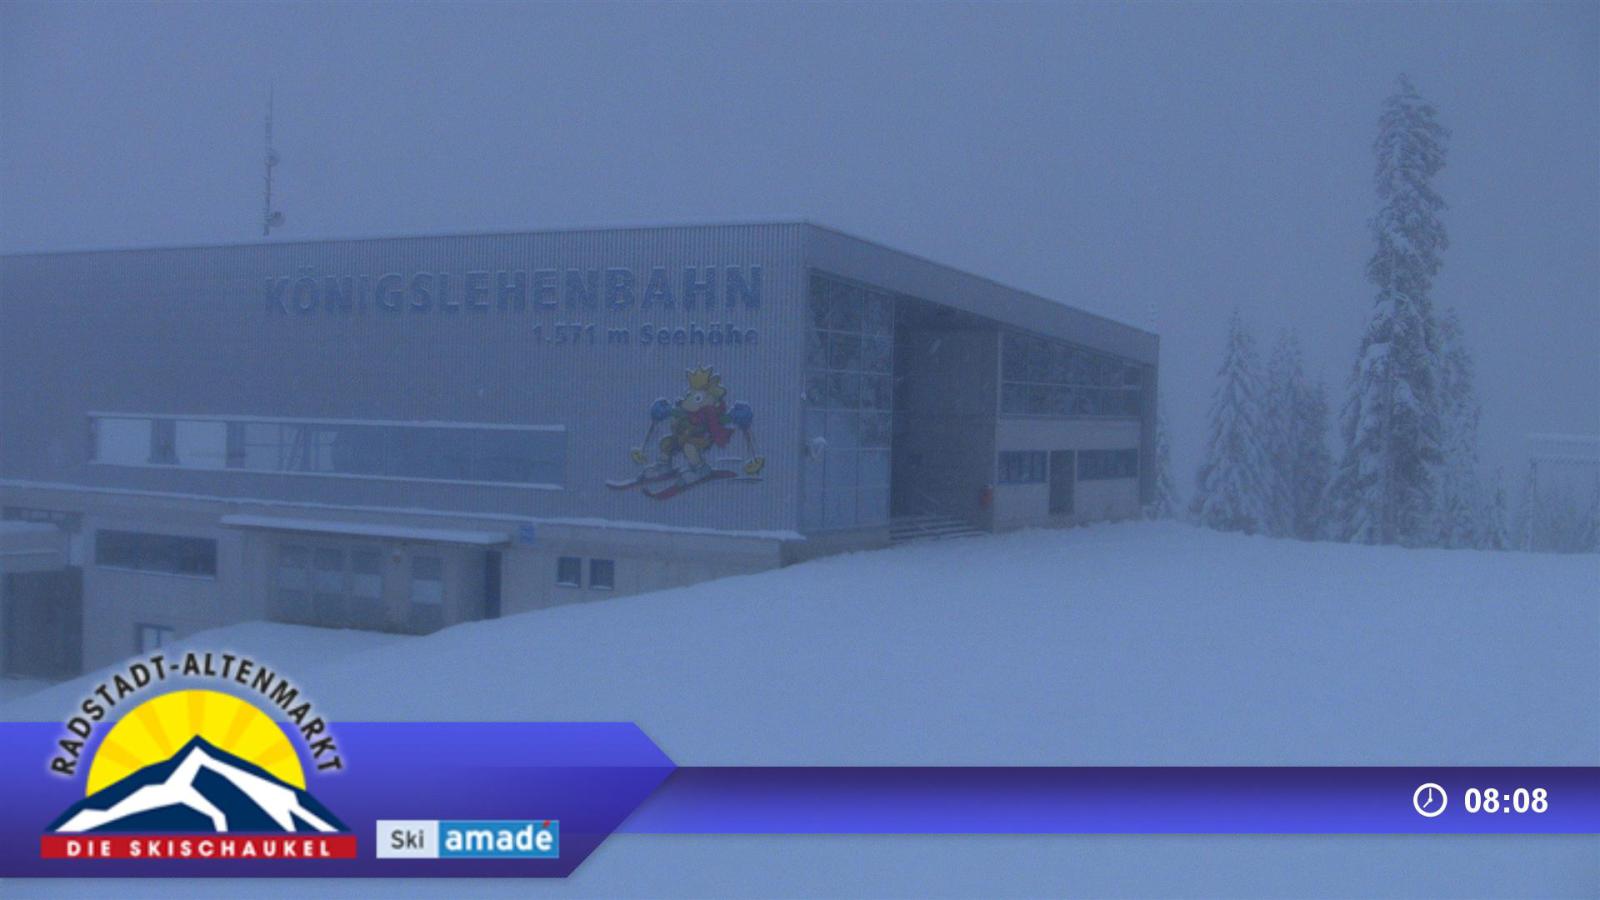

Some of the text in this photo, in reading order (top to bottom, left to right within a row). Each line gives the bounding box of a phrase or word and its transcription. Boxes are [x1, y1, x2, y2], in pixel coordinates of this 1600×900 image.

[264, 264, 763, 315] KÖNIGSLEHENBAHN
[532, 321, 759, 346] 1.571 m Seehöhe
